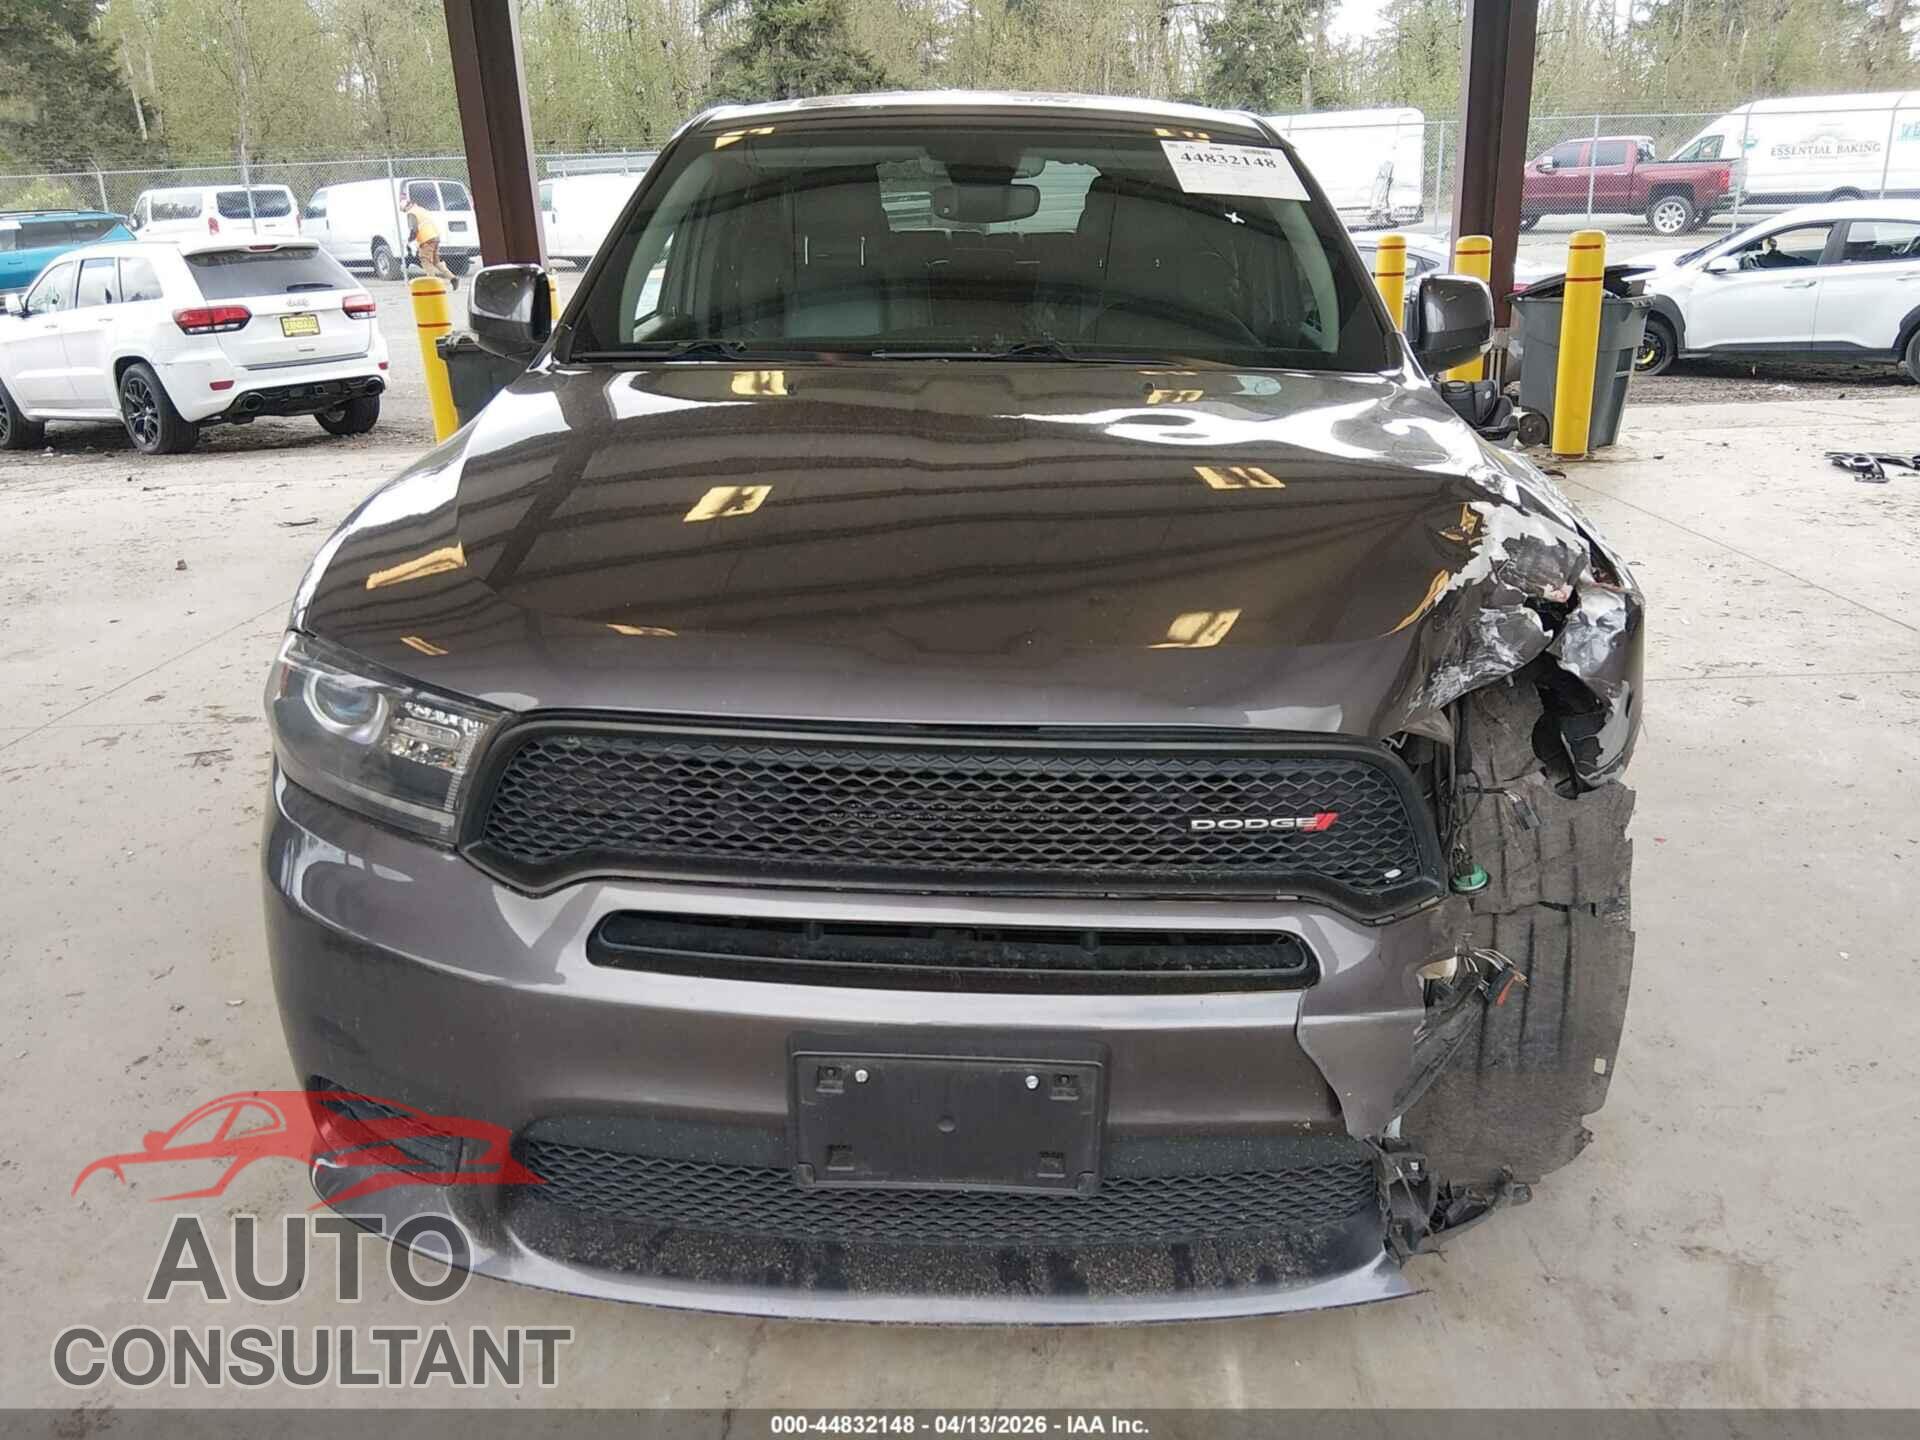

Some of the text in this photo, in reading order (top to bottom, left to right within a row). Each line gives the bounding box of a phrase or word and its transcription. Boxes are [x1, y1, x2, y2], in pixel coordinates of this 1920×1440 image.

[1770, 143, 1832, 157] ESSENTIAL
[1837, 142, 1881, 155] BAKING
[1180, 152, 1277, 168] 44832148
[1191, 817, 1318, 830] DODGE
